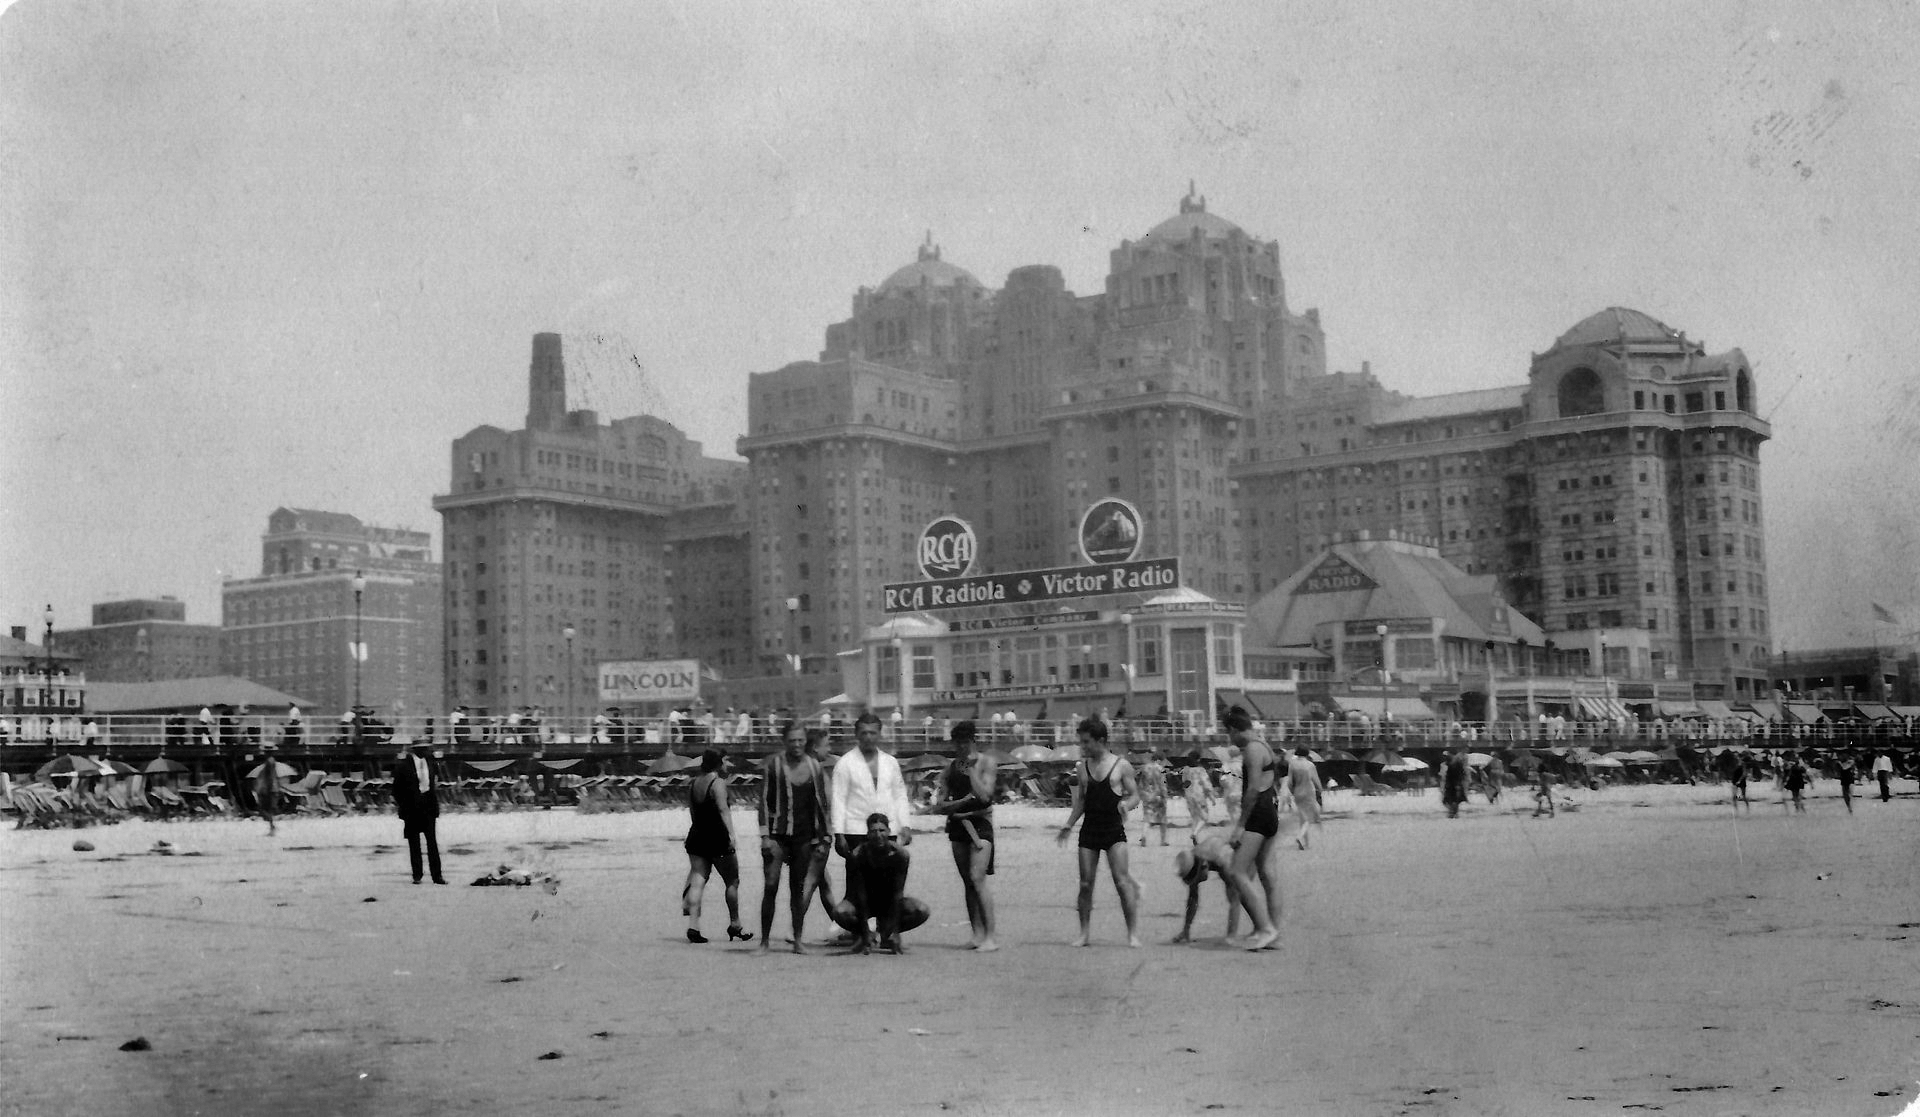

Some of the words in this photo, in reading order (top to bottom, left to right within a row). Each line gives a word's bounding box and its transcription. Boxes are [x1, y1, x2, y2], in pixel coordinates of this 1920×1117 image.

[923, 532, 970, 570] RCA
[885, 587, 925, 611] RCA
[932, 580, 1006, 605] Radiola
[1042, 572, 1107, 594] Victor
[1112, 564, 1175, 589] Radio
[1308, 575, 1361, 590] RADIO
[989, 617, 1026, 629] Victor
[603, 672, 694, 690] LINCOLN
